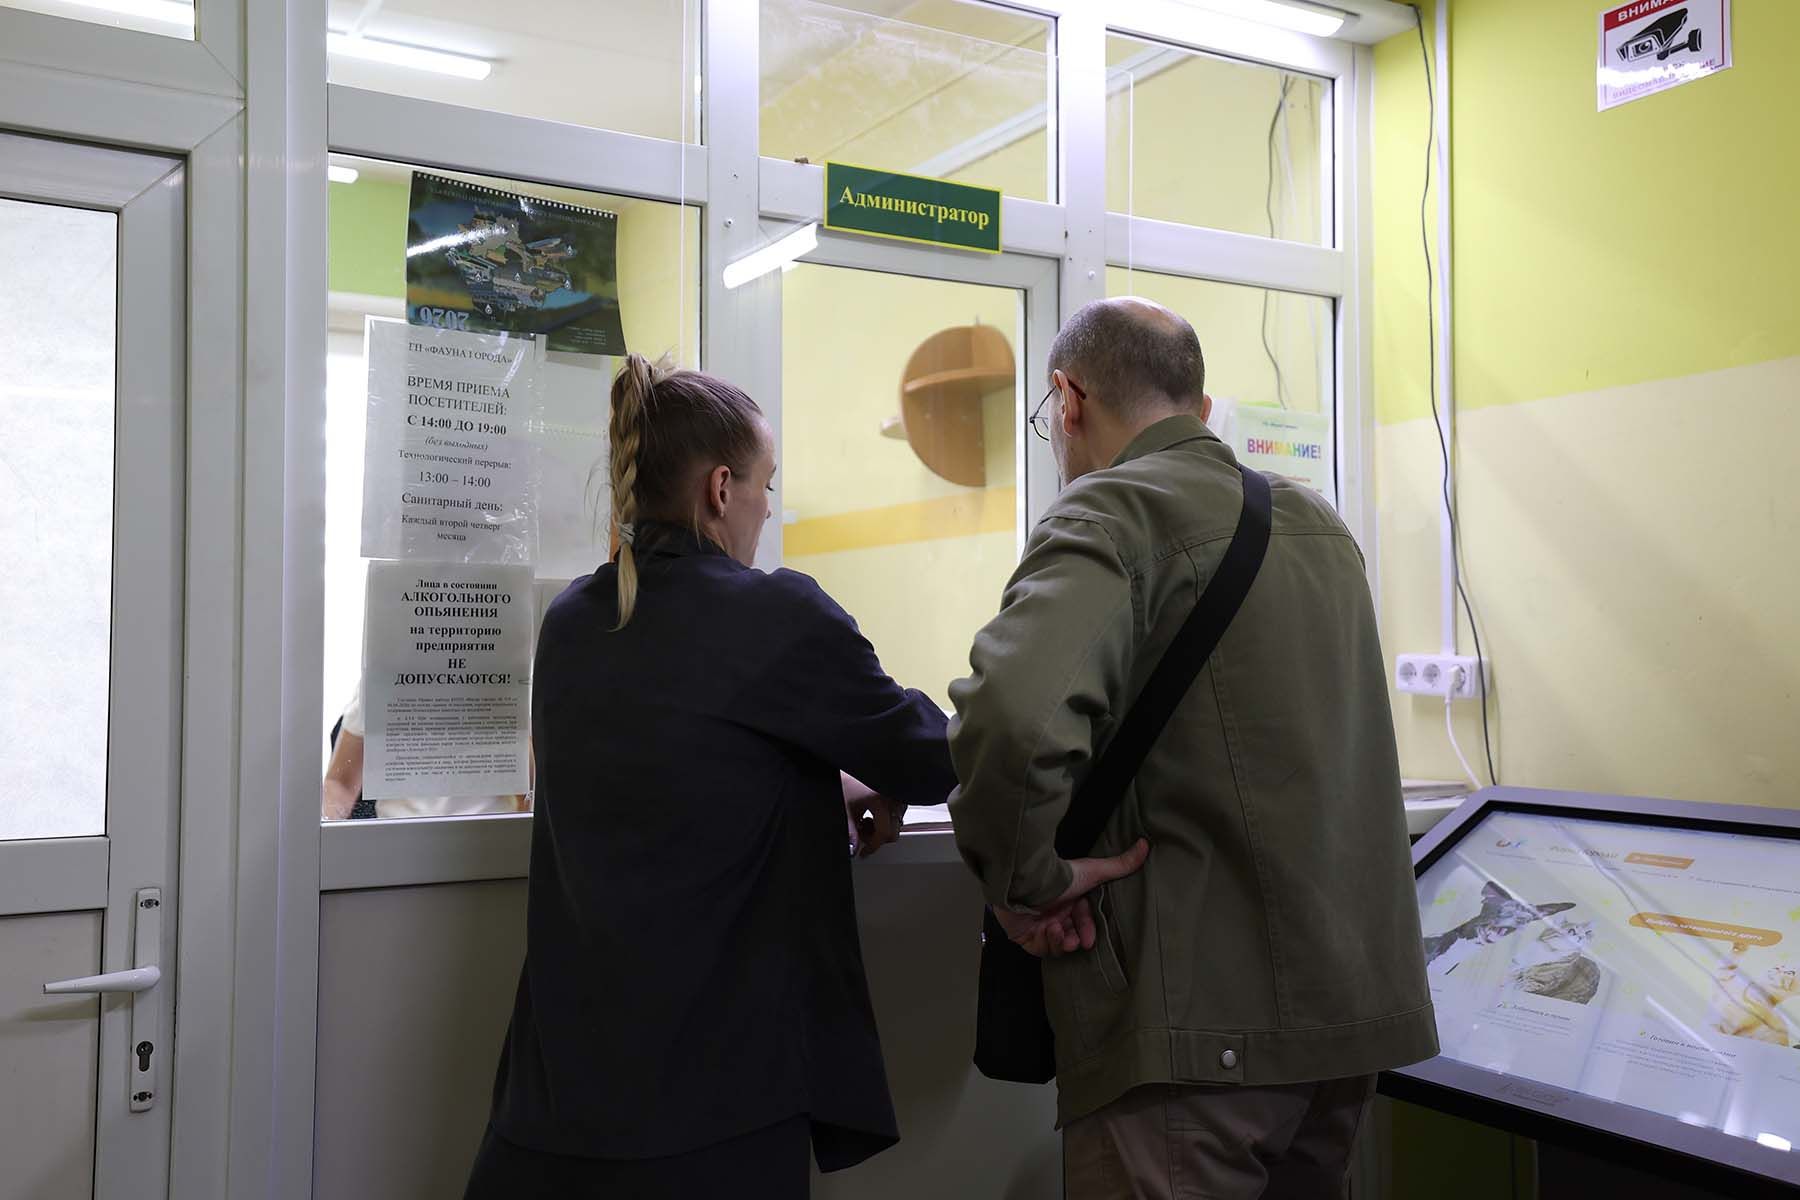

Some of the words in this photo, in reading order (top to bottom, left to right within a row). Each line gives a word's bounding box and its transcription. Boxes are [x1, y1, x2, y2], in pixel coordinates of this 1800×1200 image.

[839, 186, 990, 230] Администратор
[408, 342, 422, 352] ГП
[424, 346, 466, 358] «ФАУНА
[407, 375, 453, 392] ВРЕМЯ
[456, 381, 510, 398] ПРИЕМА
[408, 394, 508, 416] ПОСЕТИТЕЛЕЙ:
[407, 415, 418, 425] С
[421, 416, 452, 429] 14:00
[454, 420, 474, 432] ДО
[478, 422, 507, 435] 19:00
[1247, 438, 1321, 459] ВНИМАНИЕ!
[399, 450, 473, 465] Технологический
[474, 459, 512, 470] перерыв:
[420, 471, 449, 484] 13:00
[463, 475, 491, 488] 14:00
[402, 492, 472, 509] Санитарный
[474, 501, 503, 512] день:
[402, 514, 437, 526] Каждый
[440, 517, 468, 529] второй
[470, 521, 501, 532] четверг
[437, 532, 466, 541] месяца
[416, 579, 440, 589] Лица
[450, 582, 498, 590] состоянии
[401, 592, 511, 604] АЛКОГОЛЬНОГО
[414, 607, 498, 618] ОПЬЯНЕНИЯ
[410, 626, 425, 635] на
[429, 626, 502, 638] территорию
[416, 642, 495, 653] предприятия
[448, 658, 467, 669] НЕ
[394, 673, 511, 686] ДОПУСКАЮТСЯ!
